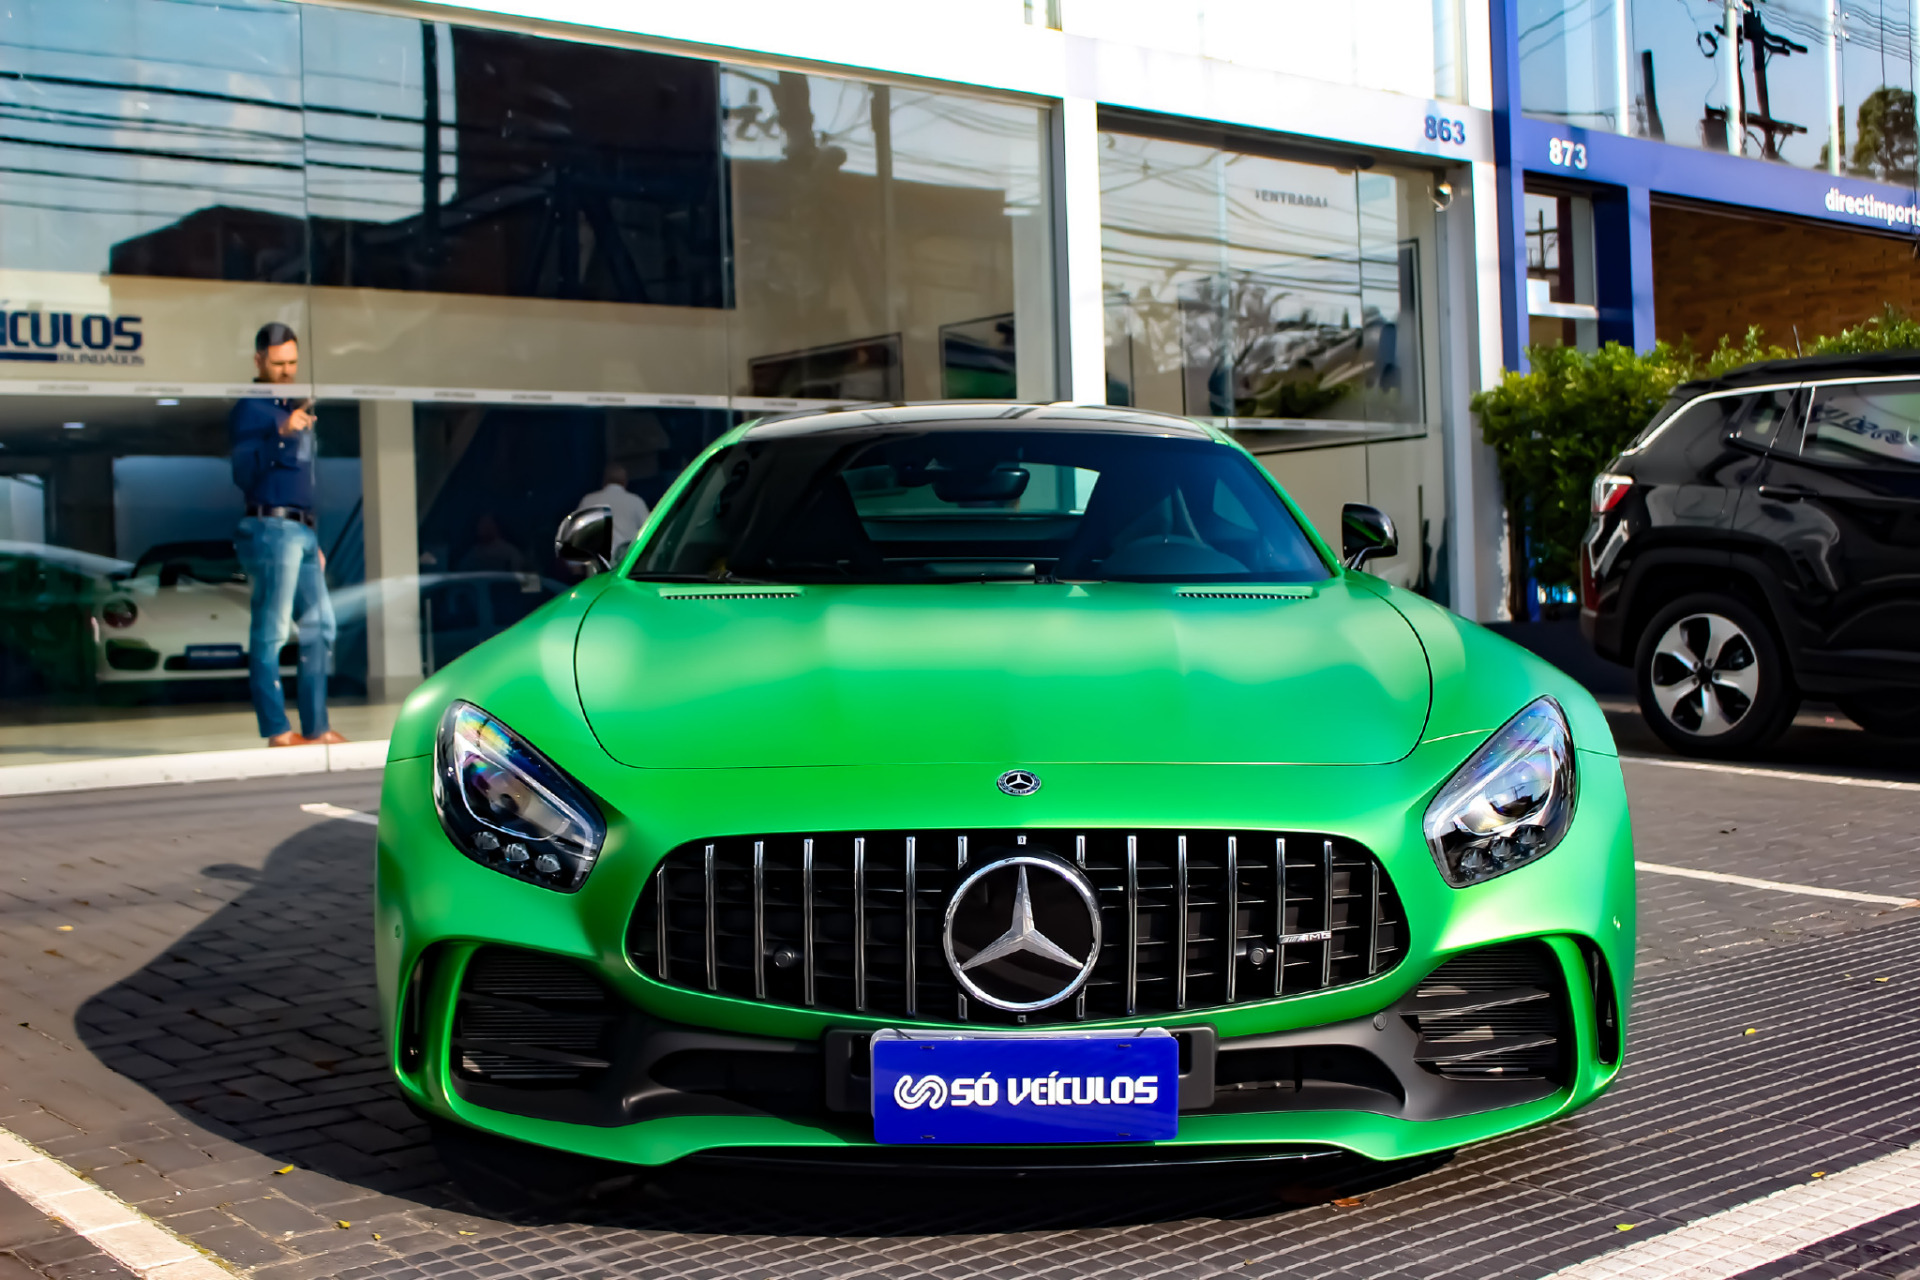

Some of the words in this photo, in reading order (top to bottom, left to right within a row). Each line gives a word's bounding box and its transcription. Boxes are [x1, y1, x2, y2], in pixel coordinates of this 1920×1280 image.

[1424, 115, 1466, 145] 863
[1549, 137, 1588, 170] 873
[1297, 930, 1332, 942] AMG
[950, 1072, 999, 1106] SÓ
[1007, 1071, 1158, 1106] VEÍCULOS
